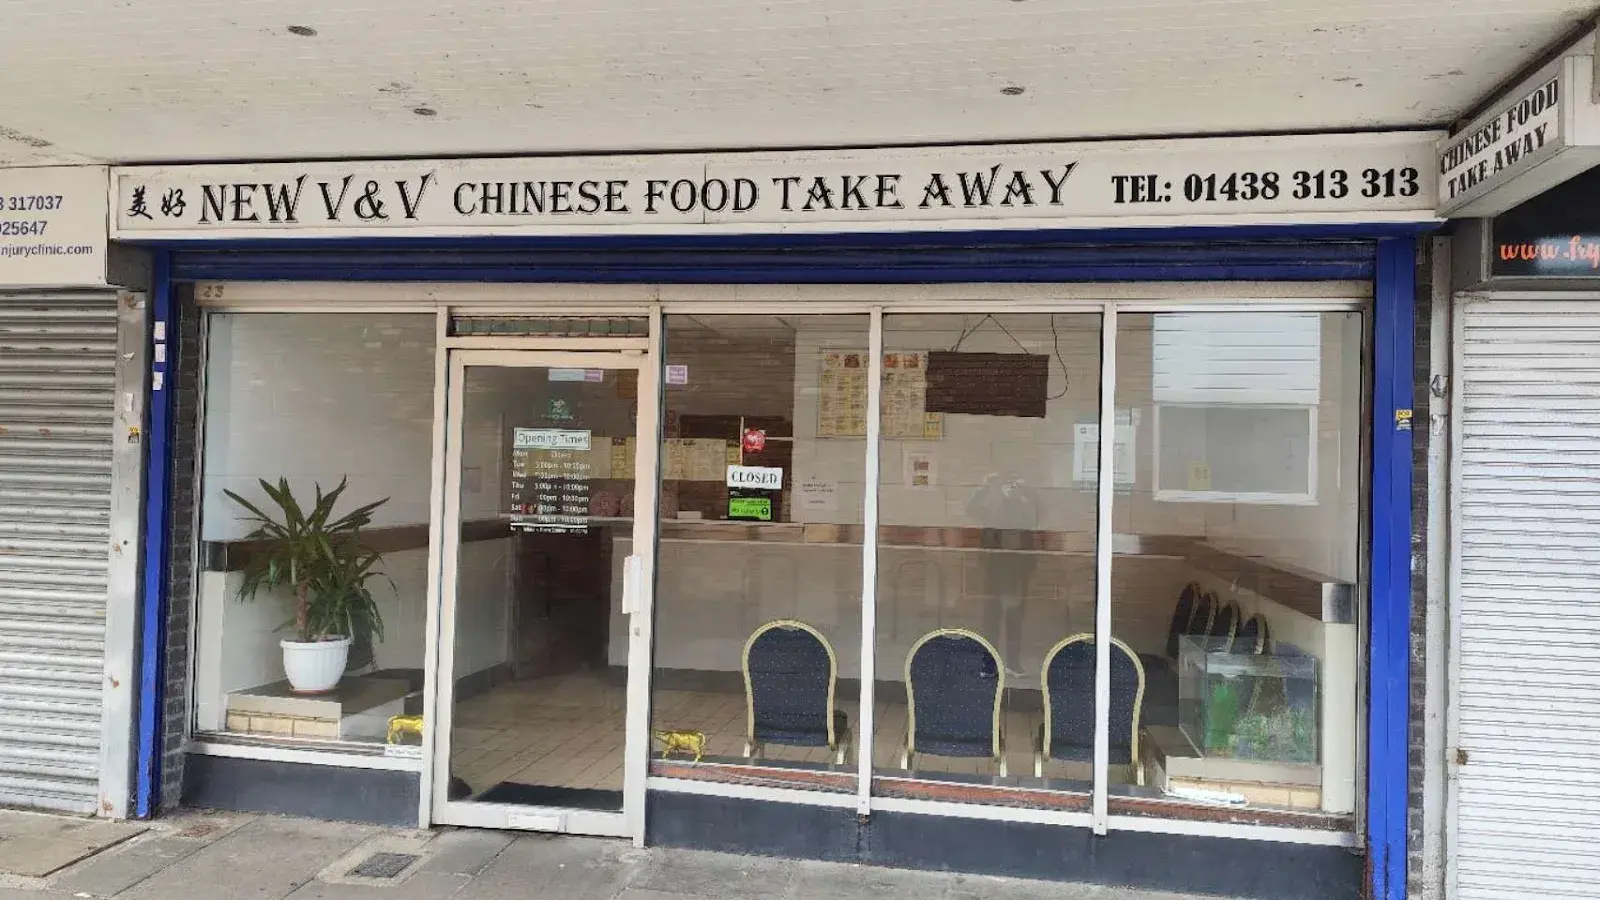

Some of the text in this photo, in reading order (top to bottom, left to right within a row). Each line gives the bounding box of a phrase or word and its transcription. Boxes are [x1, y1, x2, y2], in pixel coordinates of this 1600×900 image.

[1440, 79, 1559, 175] CHINESE FOOD
[1448, 122, 1548, 198] TAKE AWAY
[454, 161, 1079, 216] CHINESE FOOD TAKE AWAY
[1112, 166, 1420, 204] TEL: 01438 313 313
[8, 195, 64, 211] 317037
[128, 186, 187, 220] 美好
[198, 172, 433, 225] NEW V&V
[0, 220, 48, 236] 25647
[203, 285, 224, 298] 23
[518, 433, 588, 446] Opening Times
[731, 471, 778, 484] CLOSED
[511, 493, 520, 501] Fri
